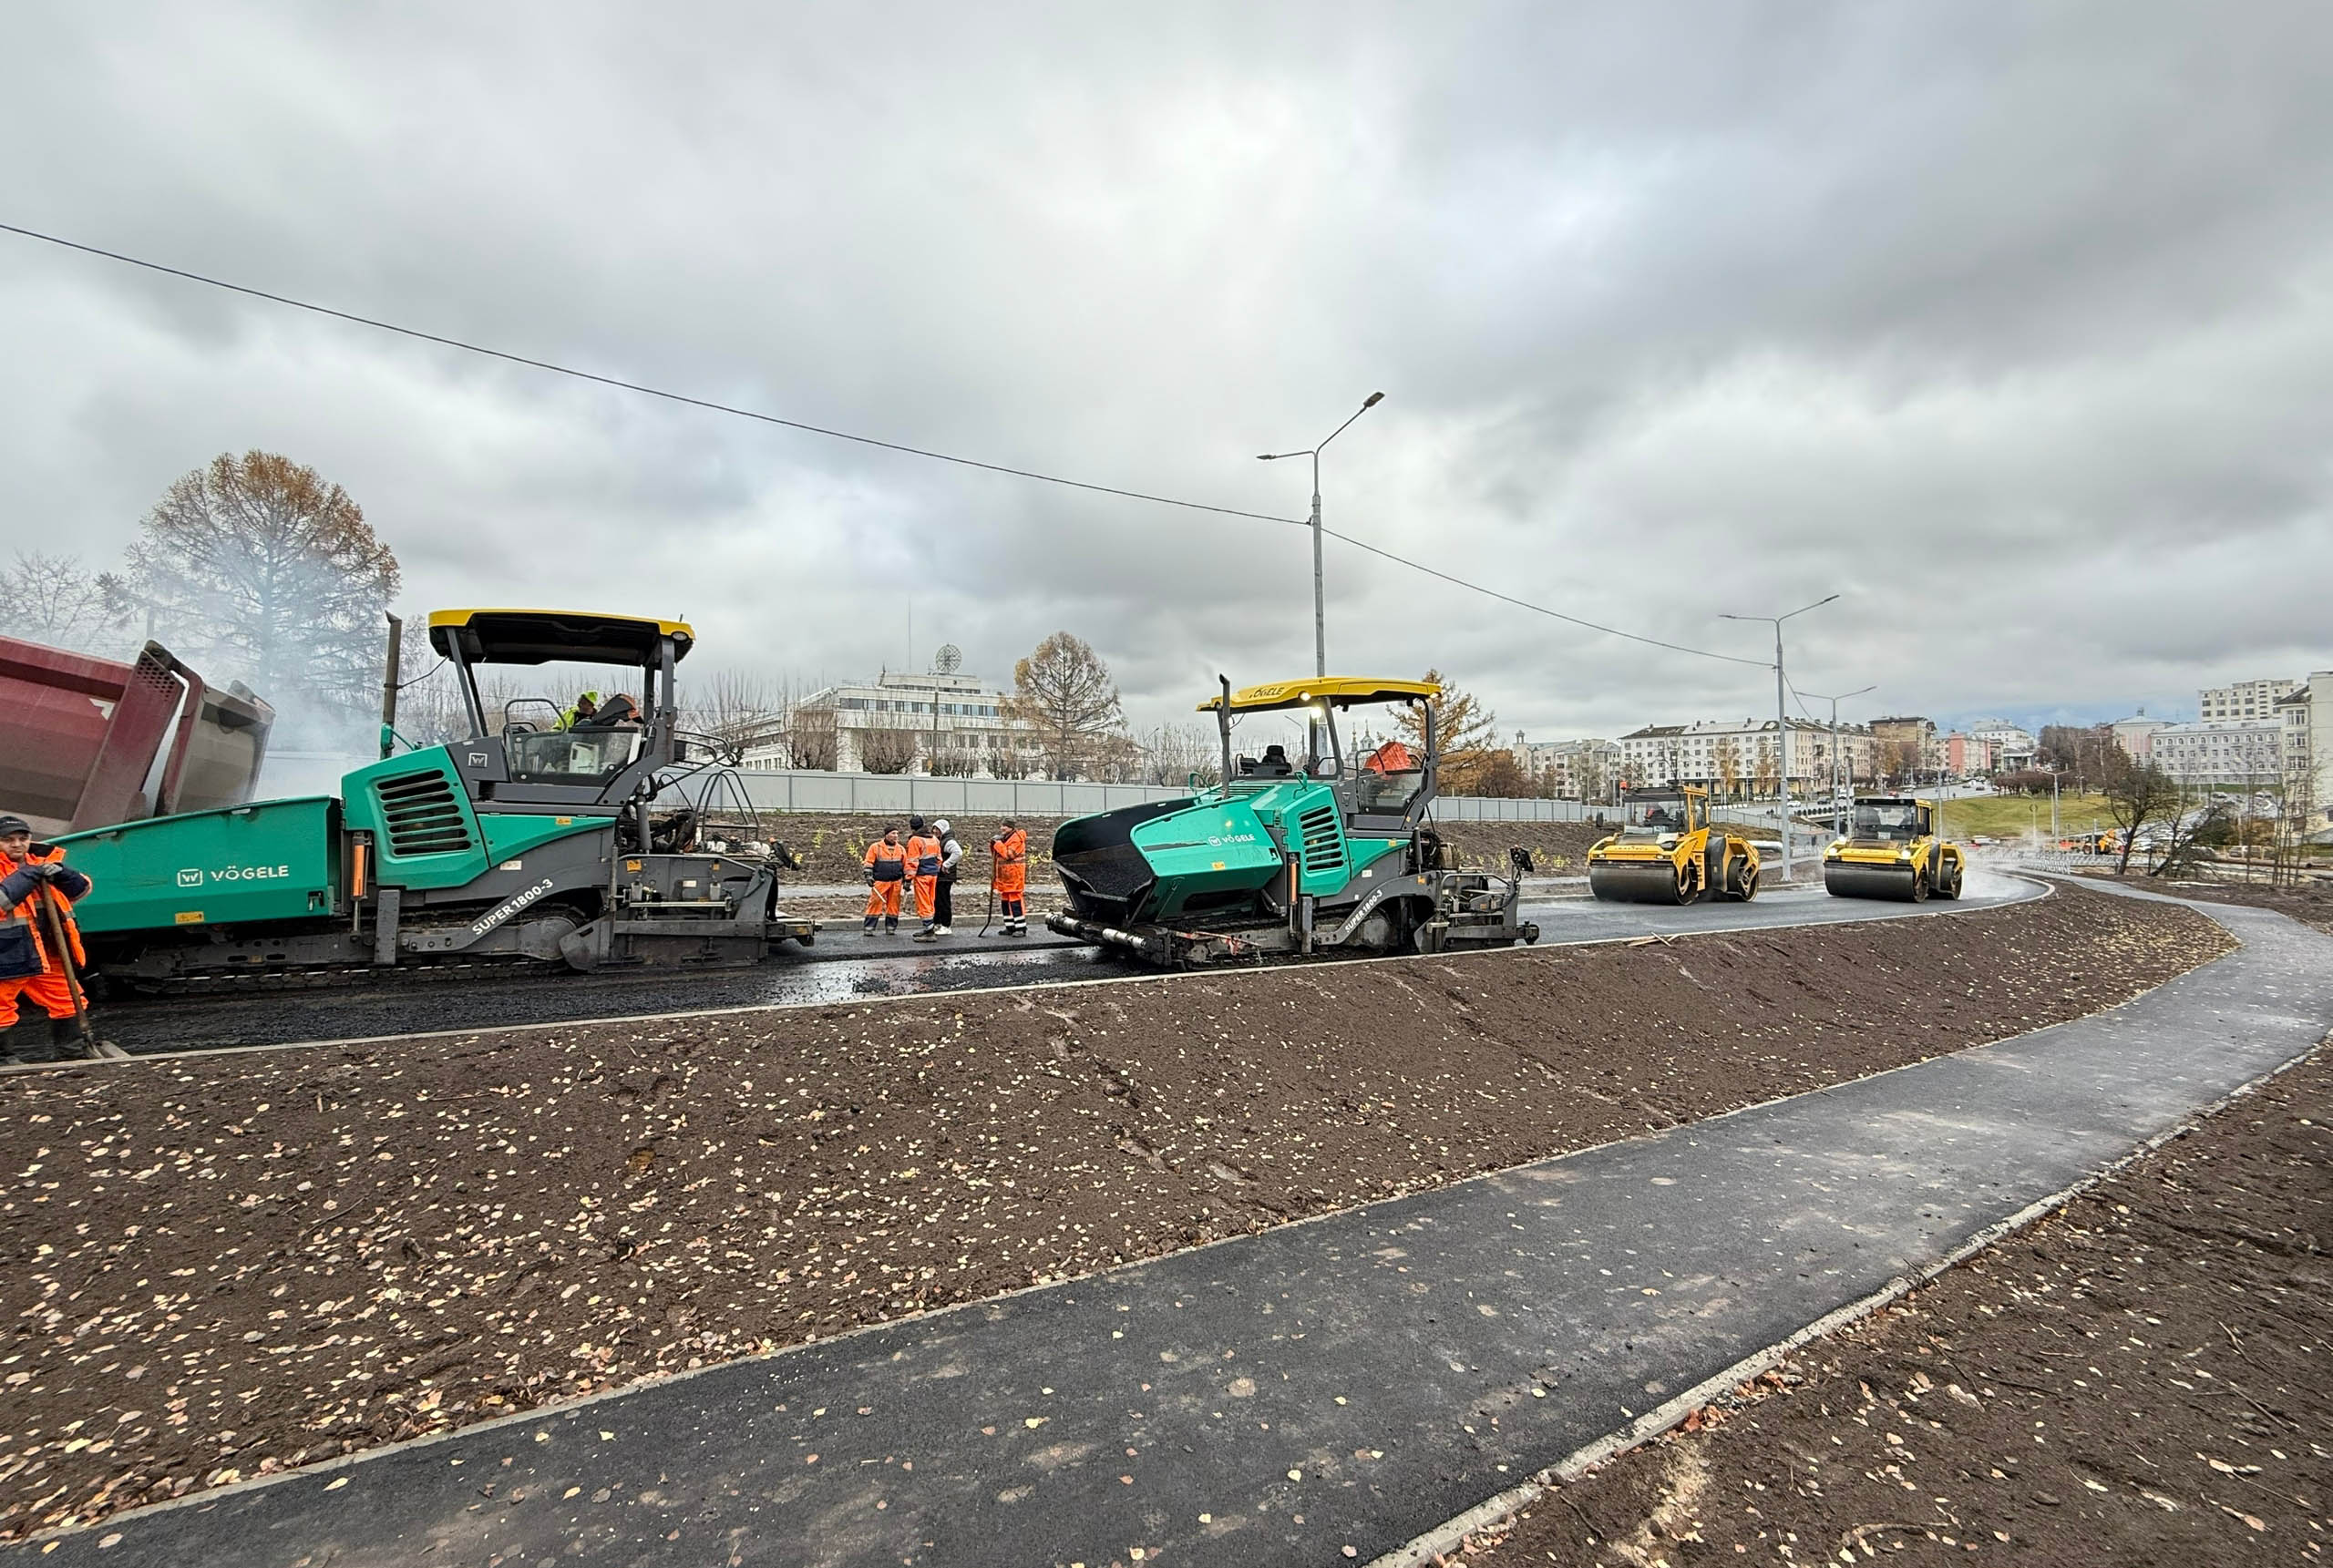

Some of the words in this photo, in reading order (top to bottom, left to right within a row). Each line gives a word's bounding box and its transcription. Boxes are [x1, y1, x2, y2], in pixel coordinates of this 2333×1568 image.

[1221, 834, 1256, 843] VÖGELE
[211, 865, 290, 882] VÖGELE
[472, 905, 515, 936] SUPER
[510, 878, 554, 908] 1800-3
[1344, 909, 1365, 933] SUPER
[1362, 889, 1383, 912] 1800-3
